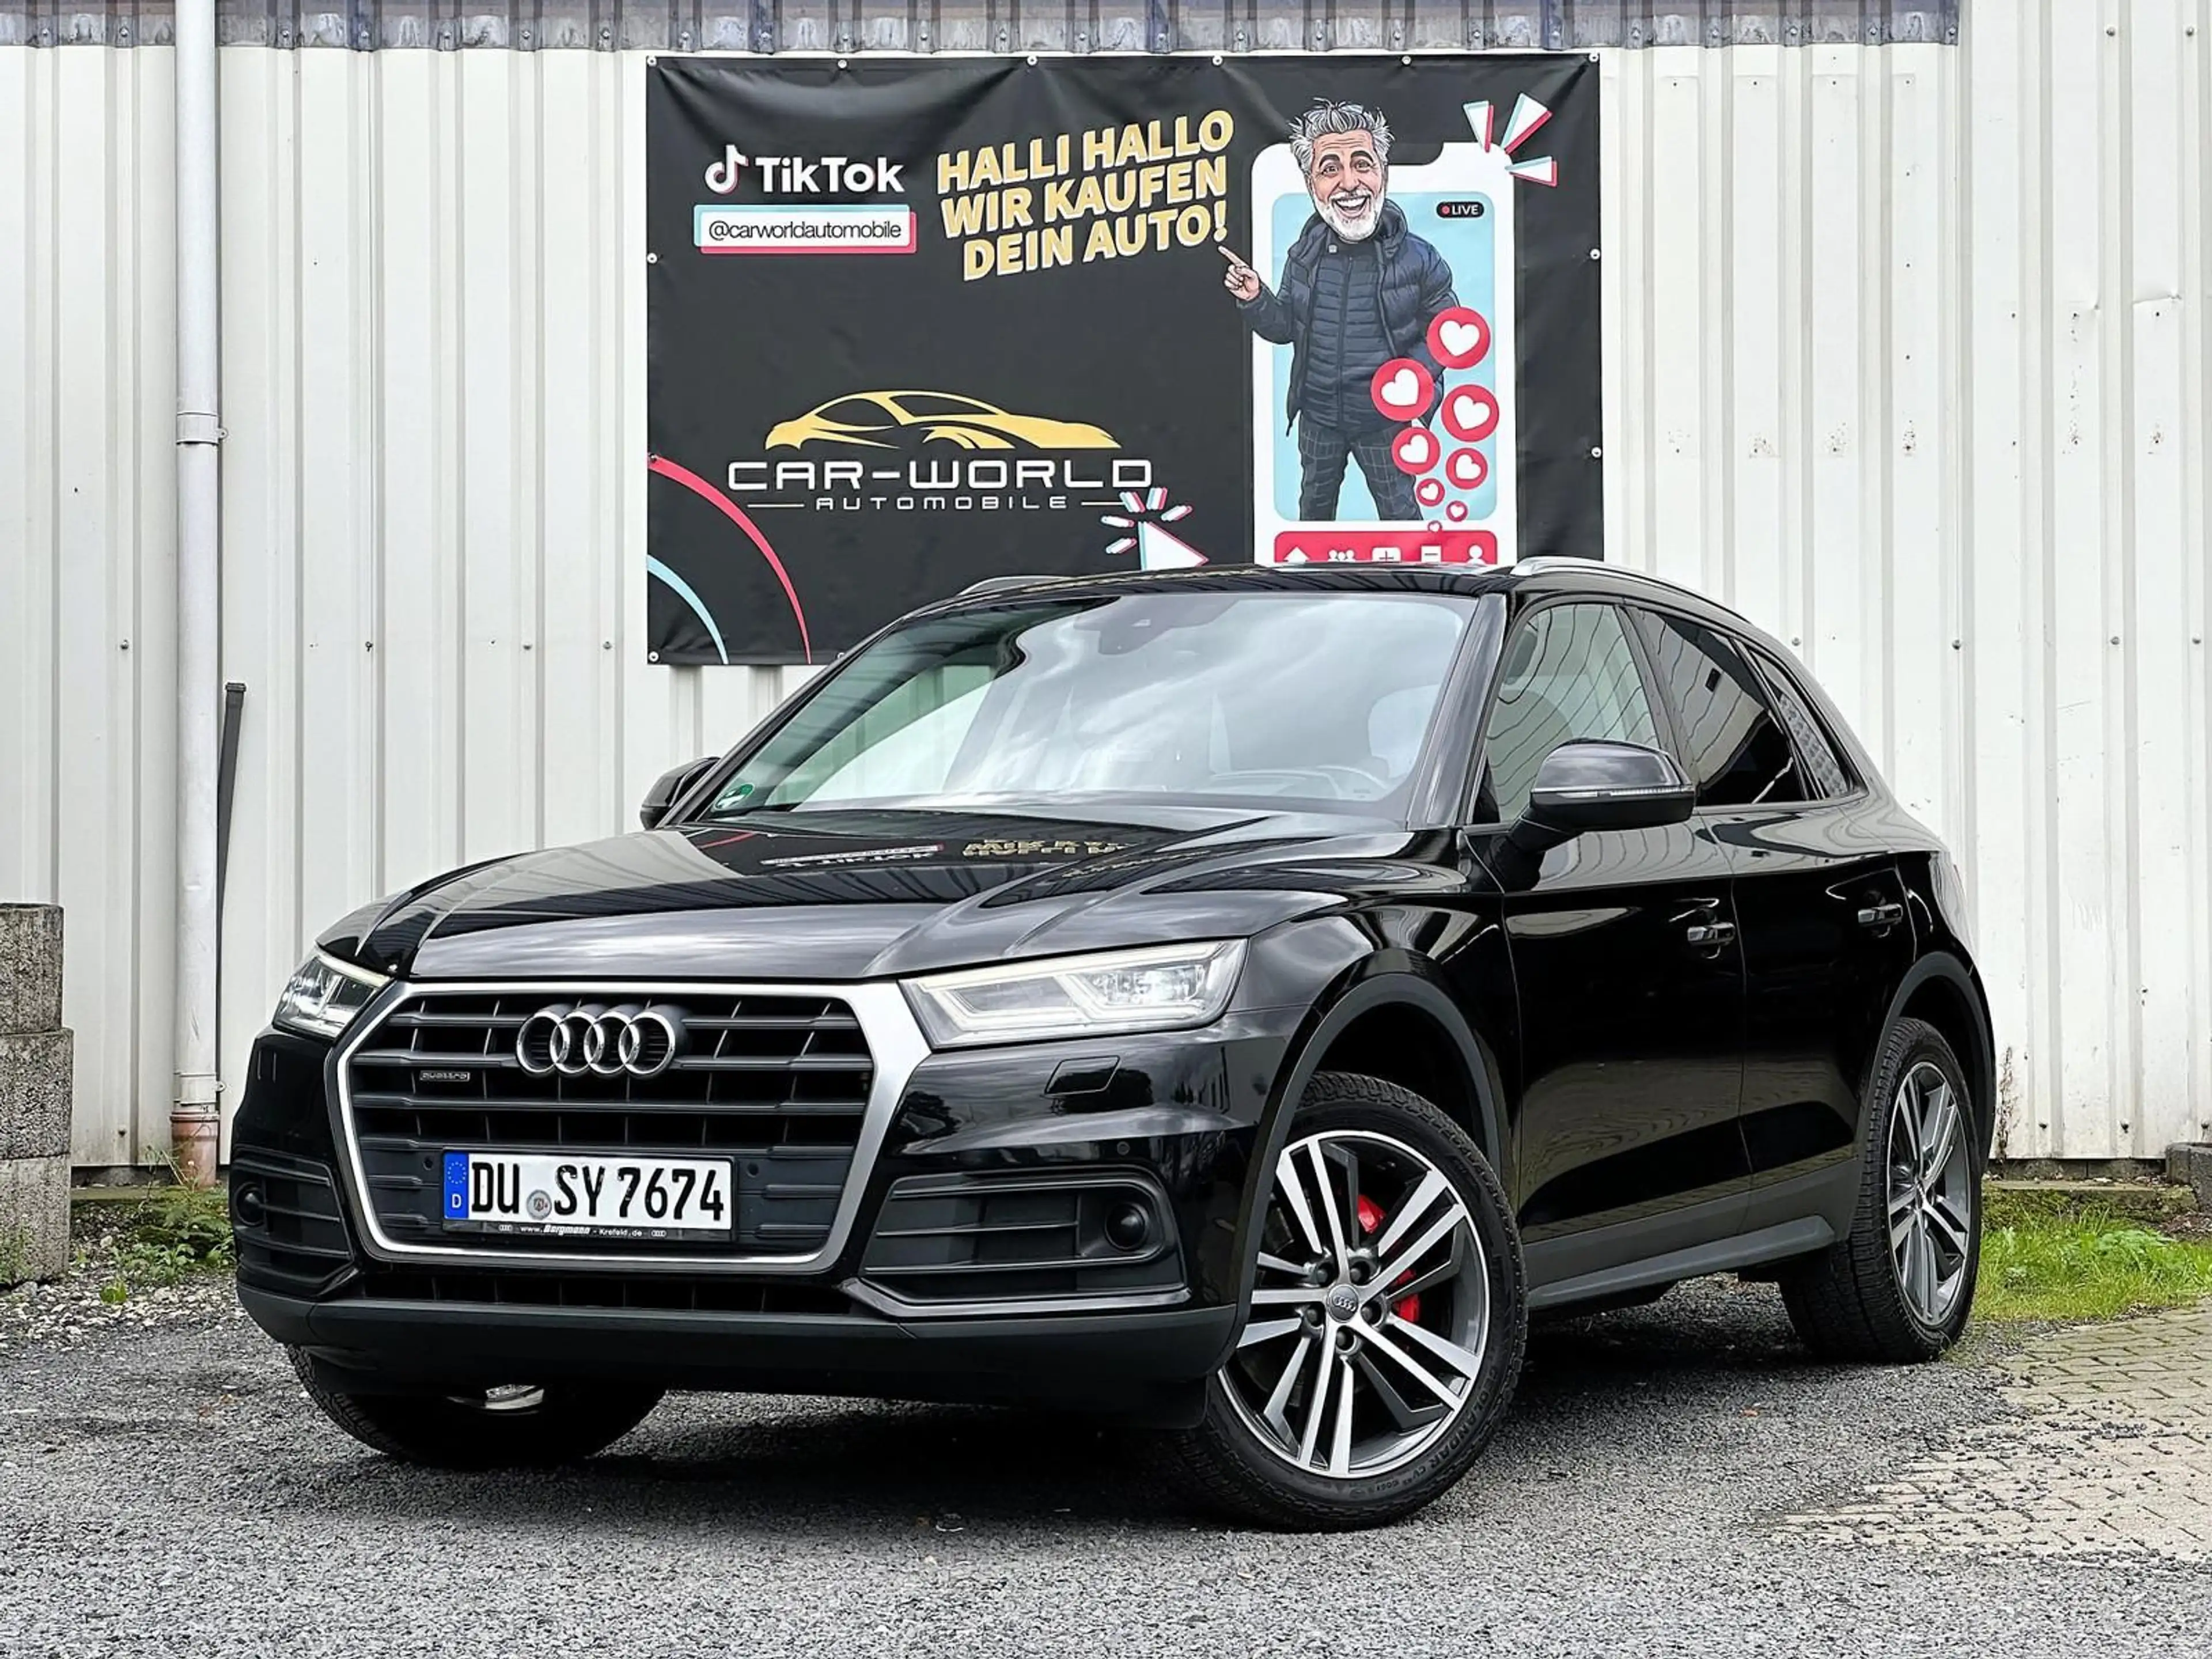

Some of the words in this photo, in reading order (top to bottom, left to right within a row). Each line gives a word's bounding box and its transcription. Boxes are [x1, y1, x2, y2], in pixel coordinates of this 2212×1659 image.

[937, 134, 1070, 194] HALLI
[1082, 110, 1234, 171] HALLO
[755, 157, 905, 192] TikTok
[941, 187, 1033, 238] WIR
[1044, 156, 1227, 223] KAUFEN
[1452, 204, 1478, 215] LIVE
[709, 221, 901, 241] @carworldautomobile
[963, 225, 1073, 281] DEIN
[1083, 200, 1227, 262] AUTO!
[728, 459, 1152, 491] CAR-WORLD
[816, 496, 1067, 510] AUTOMOBILE
[452, 1194, 461, 1208] D
[471, 1162, 520, 1214] DU
[554, 1165, 605, 1217] SY
[618, 1168, 724, 1221] 7674
